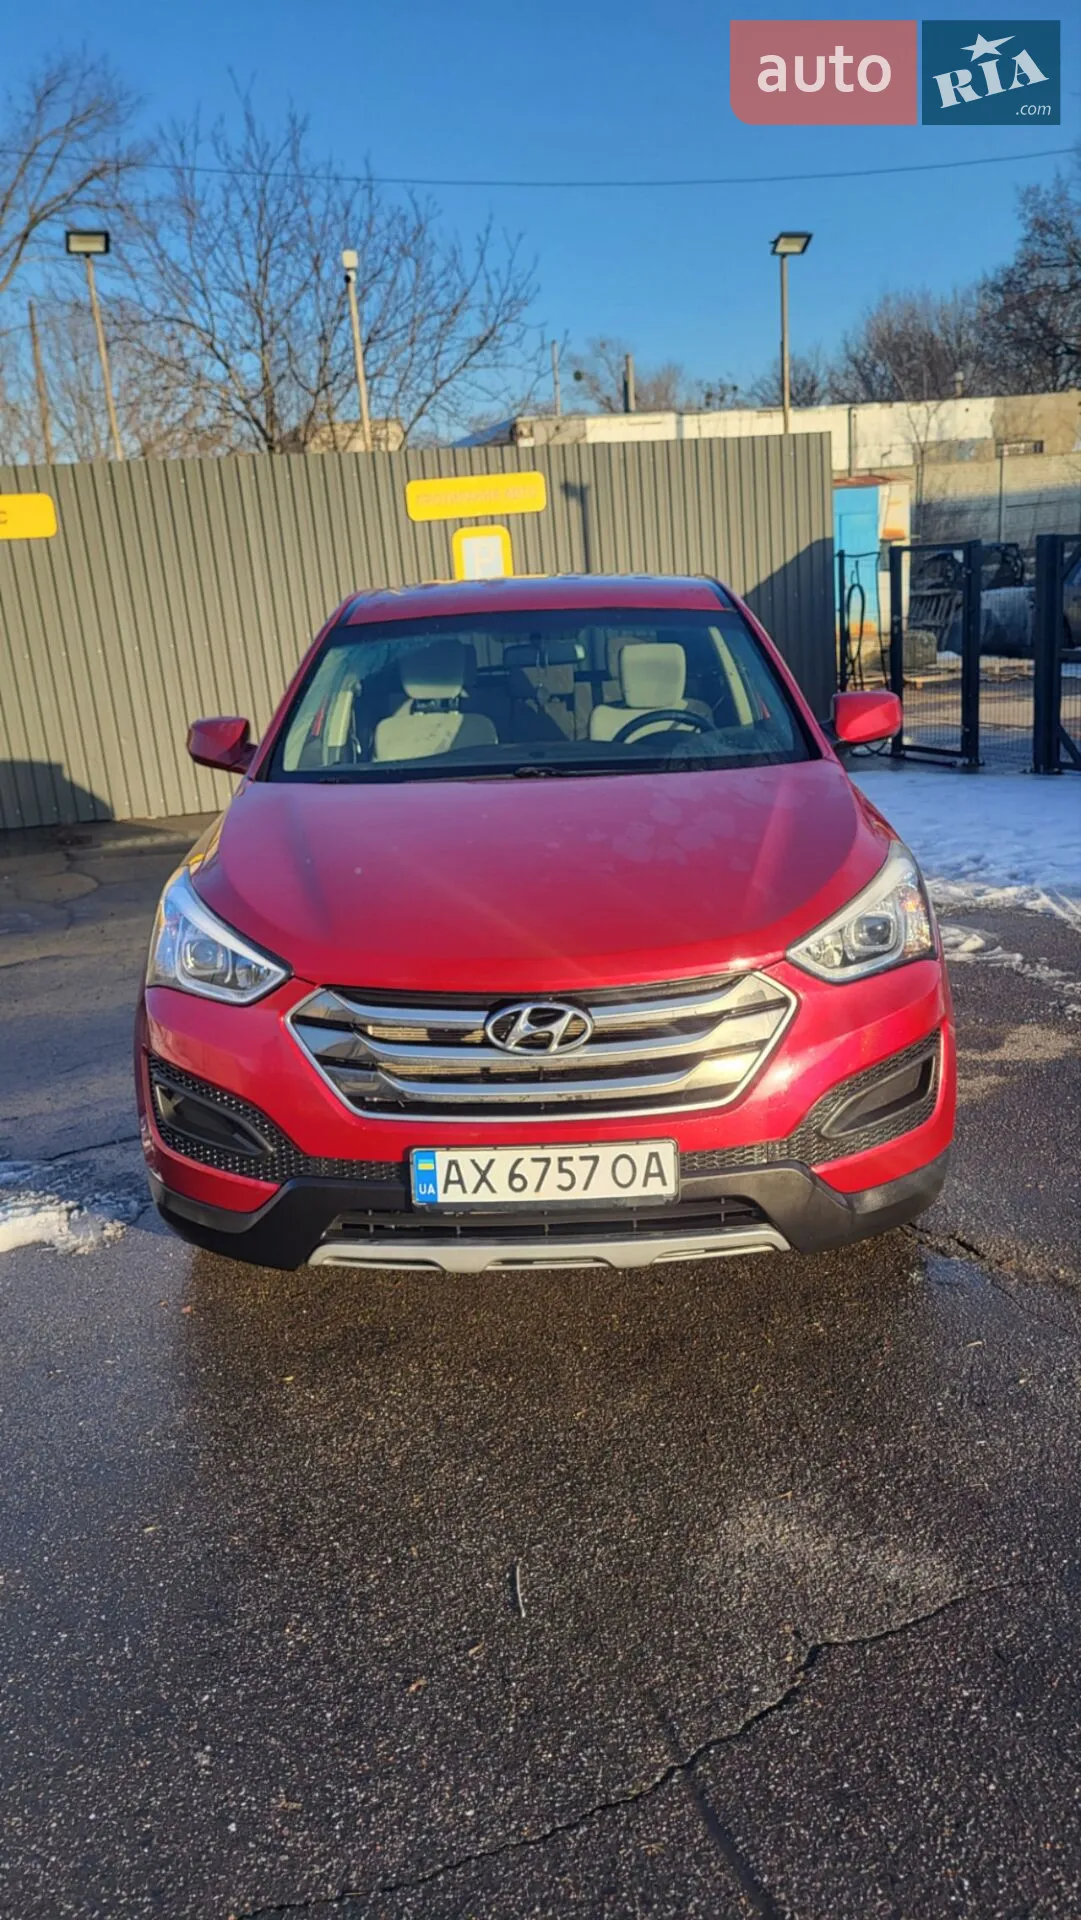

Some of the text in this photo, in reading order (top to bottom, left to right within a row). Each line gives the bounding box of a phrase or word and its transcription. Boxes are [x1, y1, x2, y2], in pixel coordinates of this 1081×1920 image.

[442, 1152, 668, 1194] AX 6757 OA
[418, 1185, 436, 1195] UA
